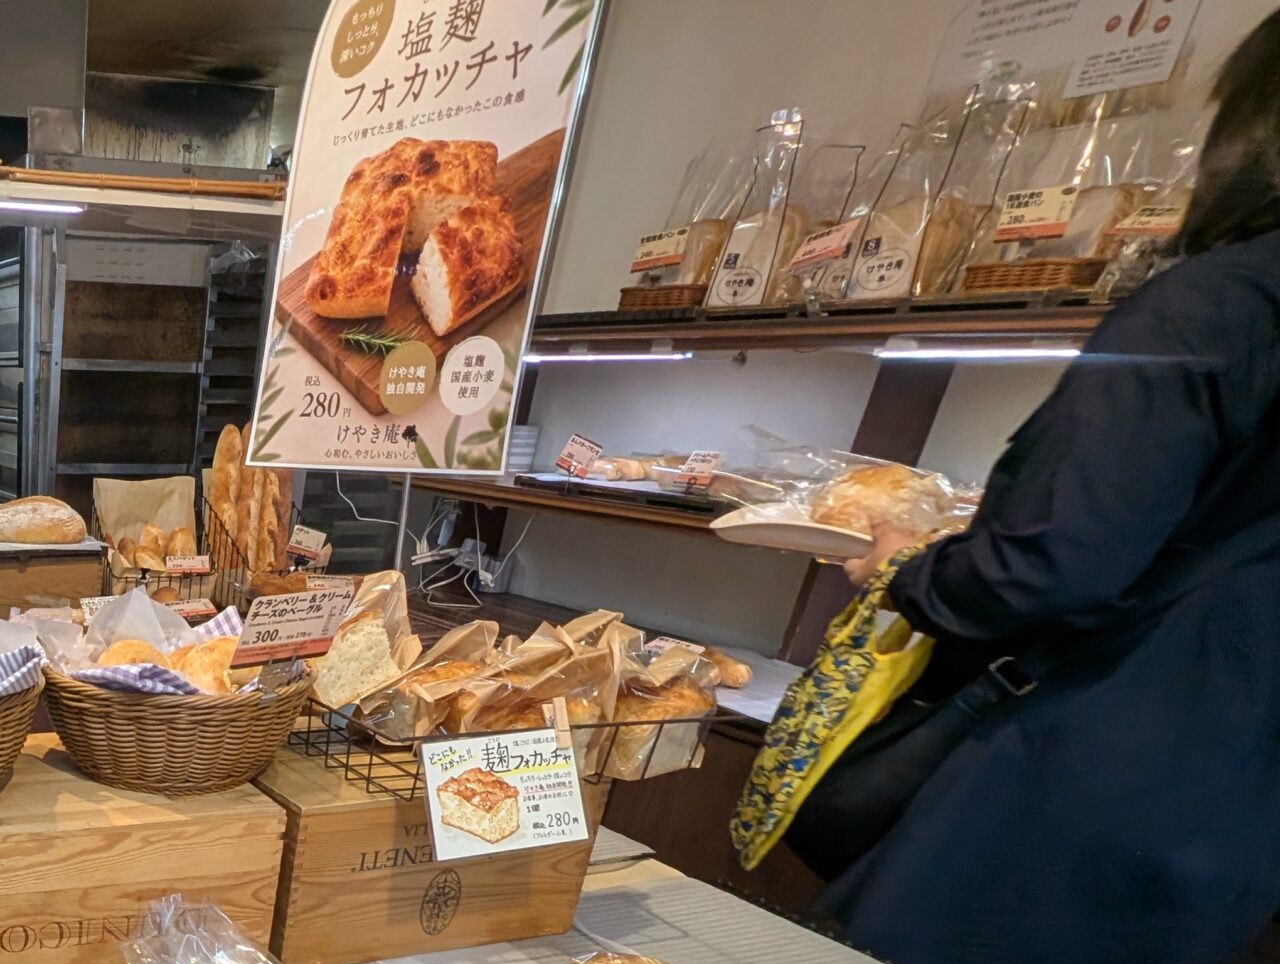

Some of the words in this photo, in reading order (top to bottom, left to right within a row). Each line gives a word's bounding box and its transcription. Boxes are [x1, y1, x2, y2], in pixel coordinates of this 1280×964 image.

[351, 3, 384, 25] もっちり
[339, 41, 376, 65] 深いコク
[388, 365, 426, 379] けやき庵
[450, 369, 495, 384] 国産小麦
[304, 375, 321, 387] 税込
[385, 381, 426, 396] 独自開発
[457, 385, 480, 399] 使用
[299, 391, 341, 418] 280
[336, 423, 401, 445] けやき庵
[252, 629, 279, 644] 300
[428, 746, 457, 765] どこにも
